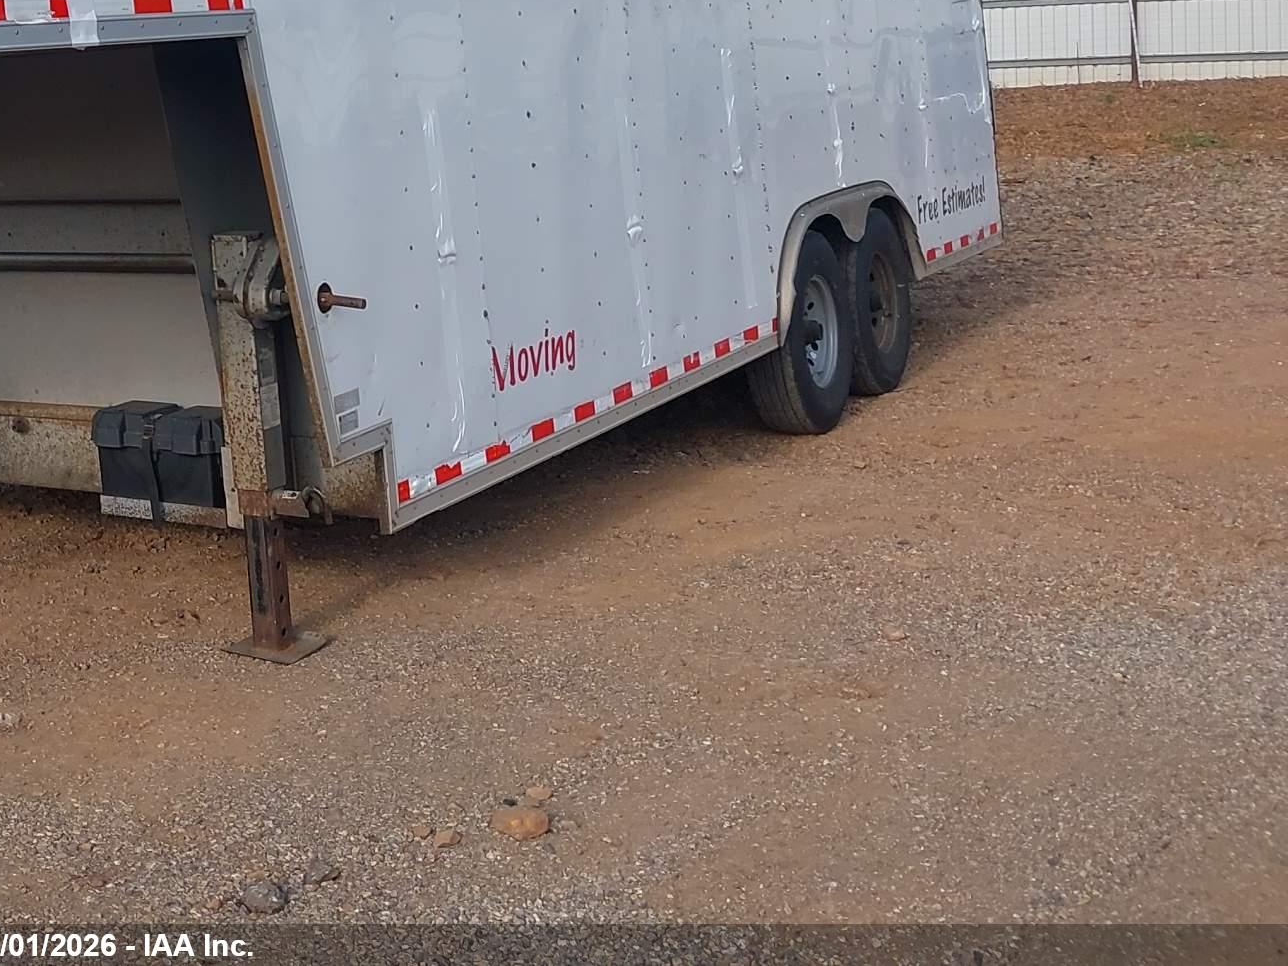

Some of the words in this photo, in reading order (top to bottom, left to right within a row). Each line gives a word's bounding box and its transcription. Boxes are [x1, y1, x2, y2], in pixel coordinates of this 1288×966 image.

[917, 195, 939, 225] Free
[941, 175, 986, 216] Estimates!
[490, 329, 575, 392] Moving
